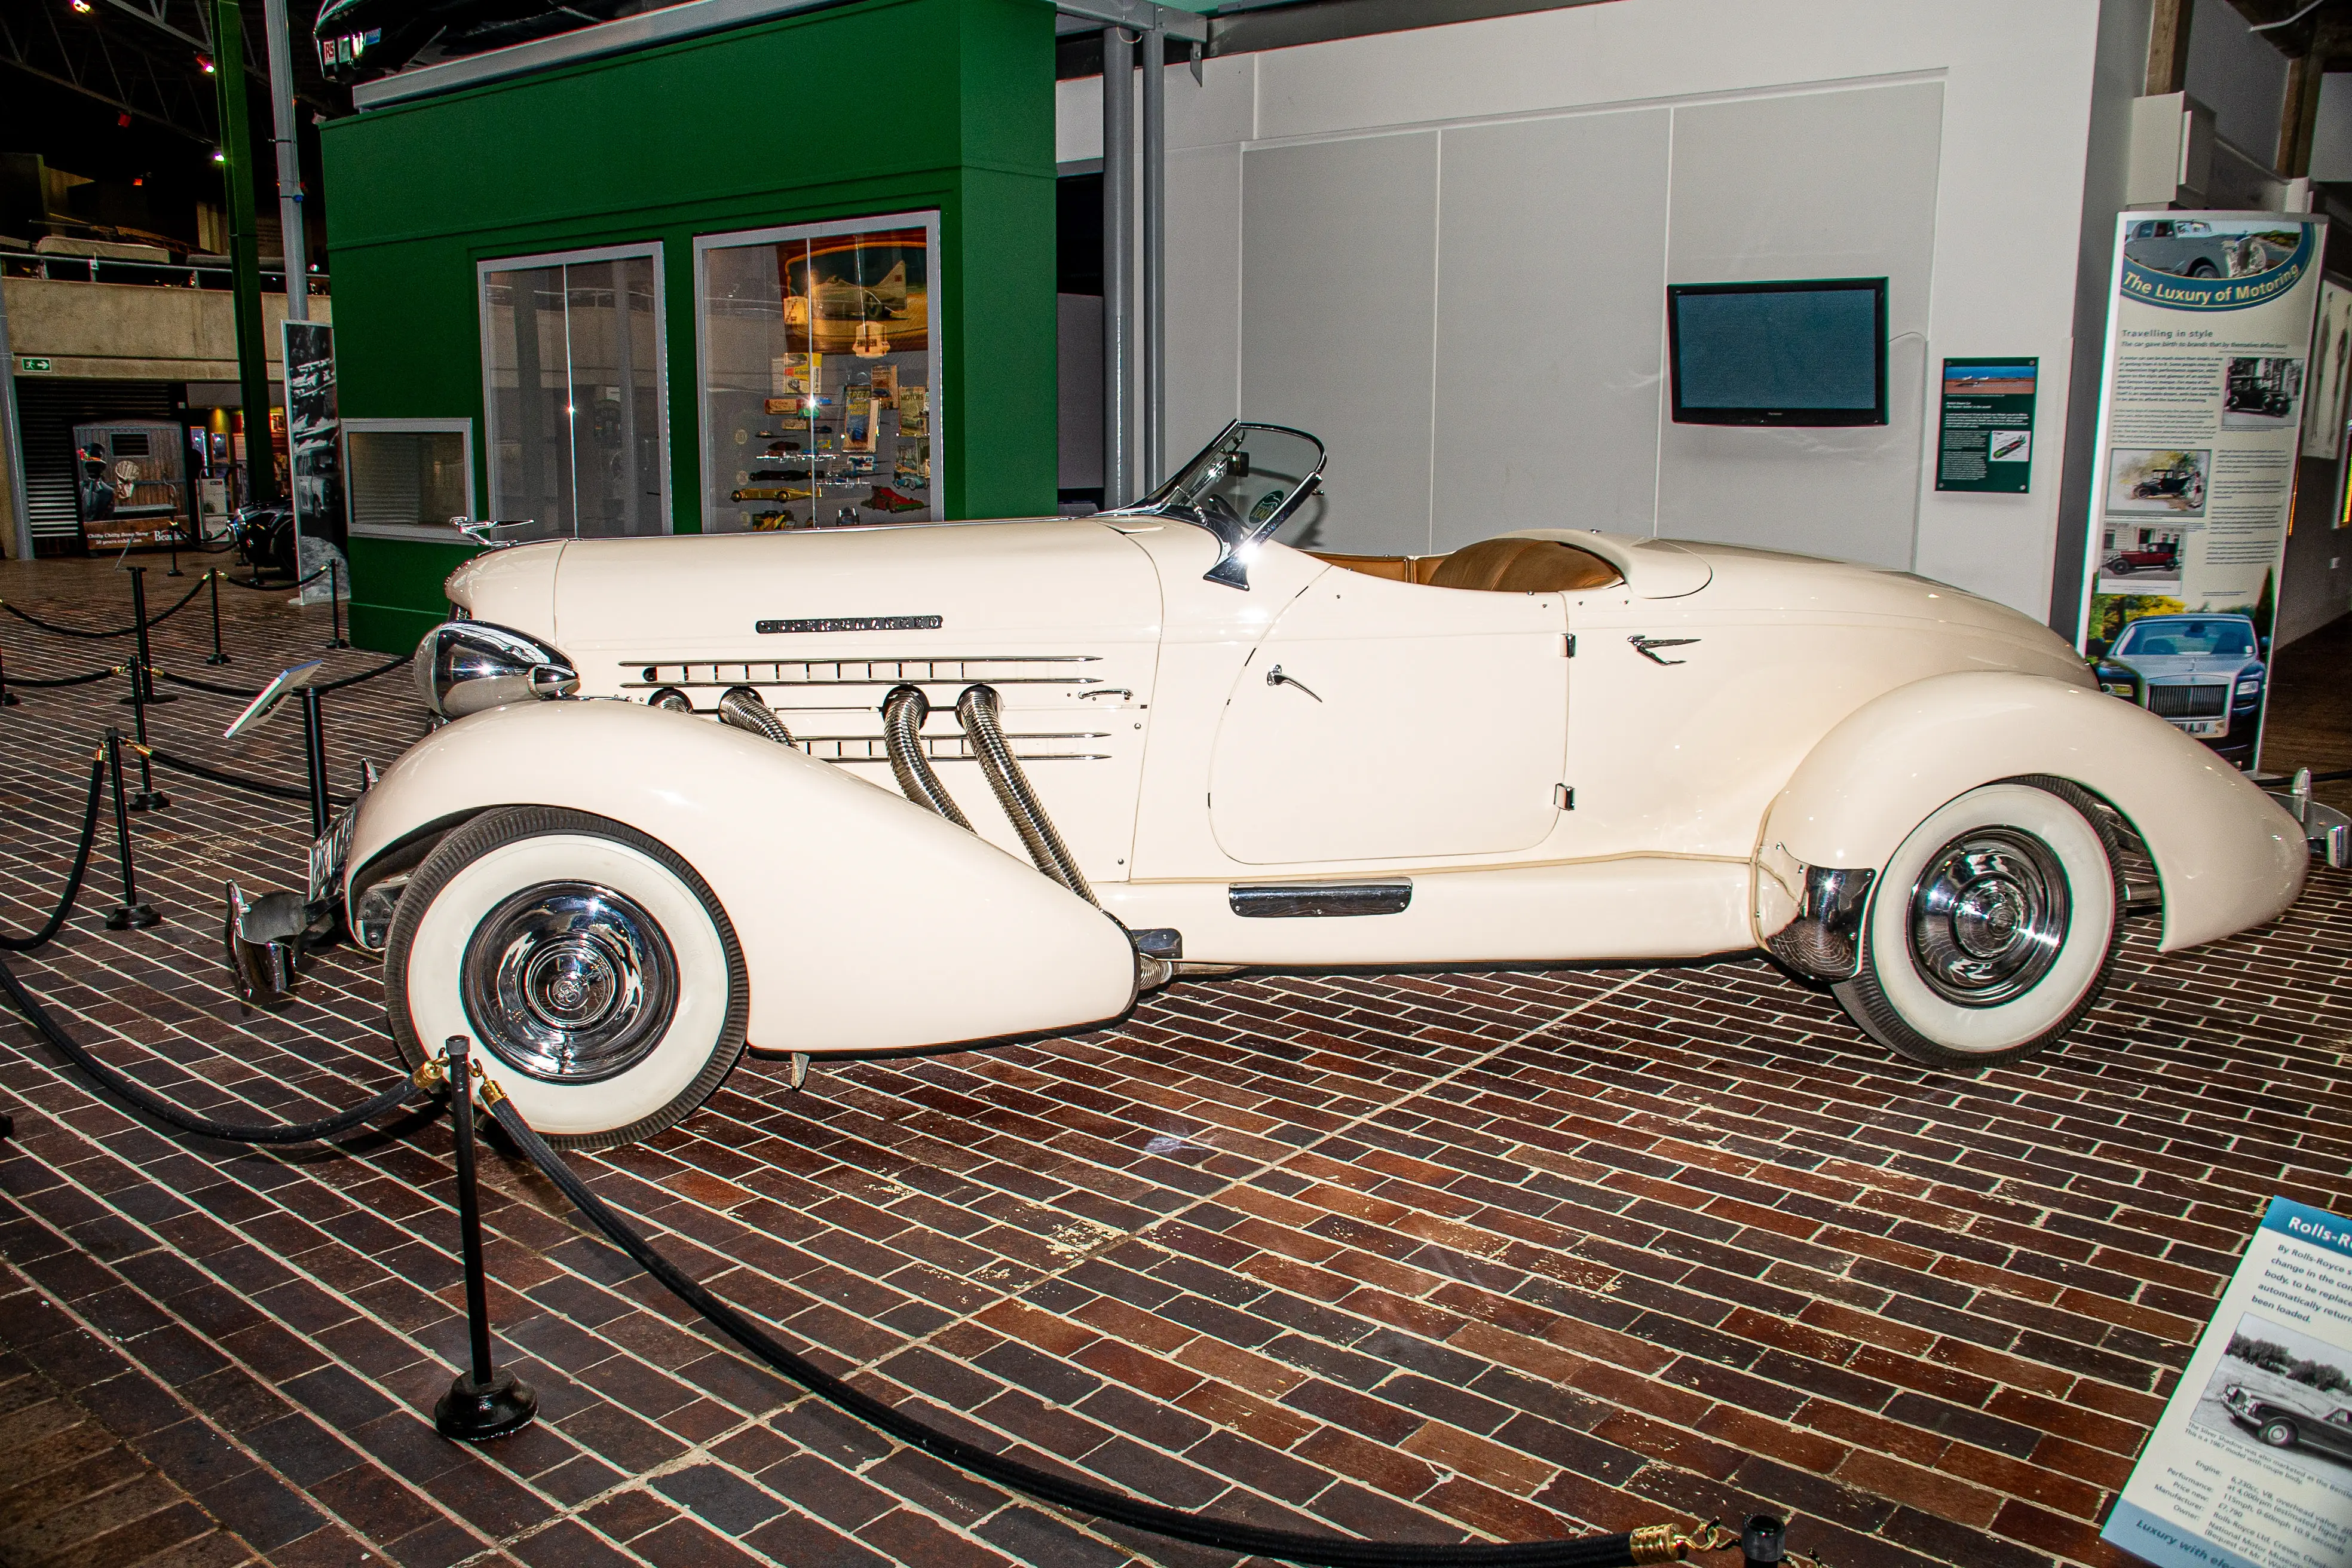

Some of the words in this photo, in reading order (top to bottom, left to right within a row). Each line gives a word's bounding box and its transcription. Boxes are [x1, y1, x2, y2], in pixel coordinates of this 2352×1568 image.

[2123, 271, 2152, 294] The
[2156, 283, 2211, 305] Luxury
[2215, 286, 2232, 302] of
[2235, 264, 2299, 299] Motoring
[2122, 329, 2173, 339] Travelling
[2189, 329, 2213, 339] style
[2288, 1216, 2352, 1248] Rolls-R
[2271, 1257, 2305, 1273] change
[2307, 1269, 2316, 1278] in
[2319, 1273, 2335, 1285] the
[2278, 1244, 2290, 1254] By
[2291, 1249, 2345, 1273] Rolls-Royce
[2258, 1283, 2322, 1311] automatically
[2264, 1269, 2289, 1284] body,
[2293, 1279, 2302, 1288] to
[2305, 1284, 2317, 1294] be
[2319, 1290, 2352, 1307] replace
[2252, 1294, 2274, 1309] been
[2277, 1304, 2311, 1323] loaded.
[2185, 1428, 2197, 1438] This
[2225, 1446, 2246, 1459] model
[2247, 1456, 2262, 1467] with
[2188, 1422, 2200, 1432] The
[2201, 1427, 2217, 1439] Silver
[2219, 1435, 2244, 1451] Shadow
[2244, 1447, 2257, 1456] was
[2258, 1452, 2271, 1462] also
[2273, 1459, 2306, 1478] marketed
[2167, 1466, 2214, 1493] Performance:
[2173, 1481, 2190, 1493] Price
[2191, 1491, 2210, 1502] new:
[2195, 1460, 2223, 1477] Engine:
[2276, 1497, 2314, 1518] overhead
[2154, 1484, 2205, 1512] Manufacturer:
[2237, 1489, 2272, 1508] 4,000rpm
[2136, 1519, 2178, 1545] Luxury
[2179, 1541, 2208, 1560] with
[2173, 1504, 2200, 1522] Owner:
[2208, 1520, 2241, 1541] National
[2242, 1537, 2267, 1552] Motor
[2204, 1528, 2237, 1549] (Bequest
